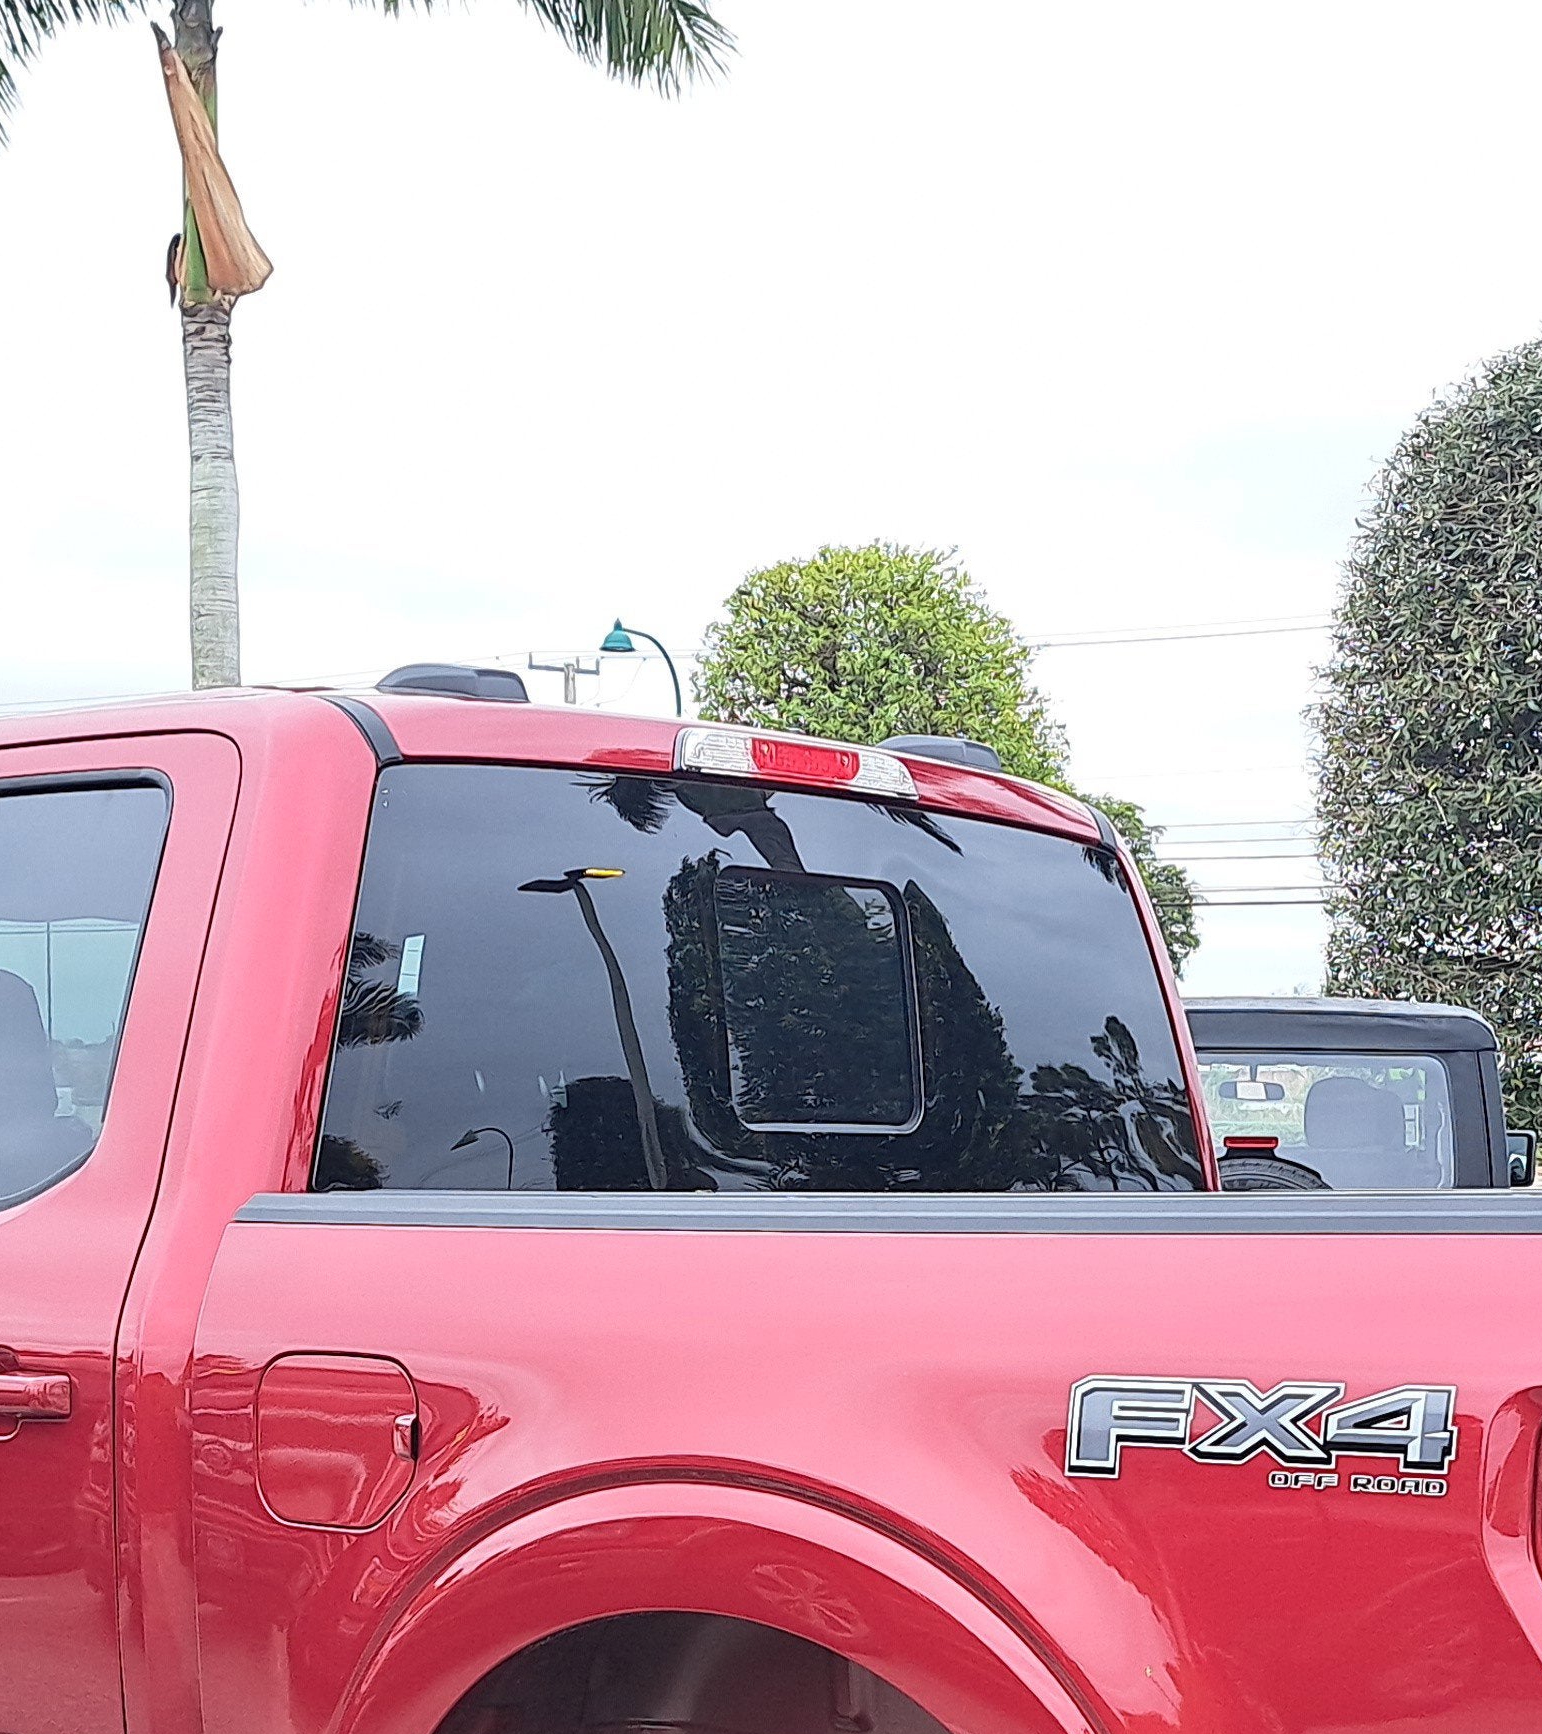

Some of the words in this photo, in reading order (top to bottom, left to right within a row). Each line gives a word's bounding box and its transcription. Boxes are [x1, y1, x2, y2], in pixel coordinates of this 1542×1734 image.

[1065, 1375, 1457, 1478] FX4
[1269, 1471, 1340, 1490] OFF
[1350, 1474, 1450, 1496] ROAD
